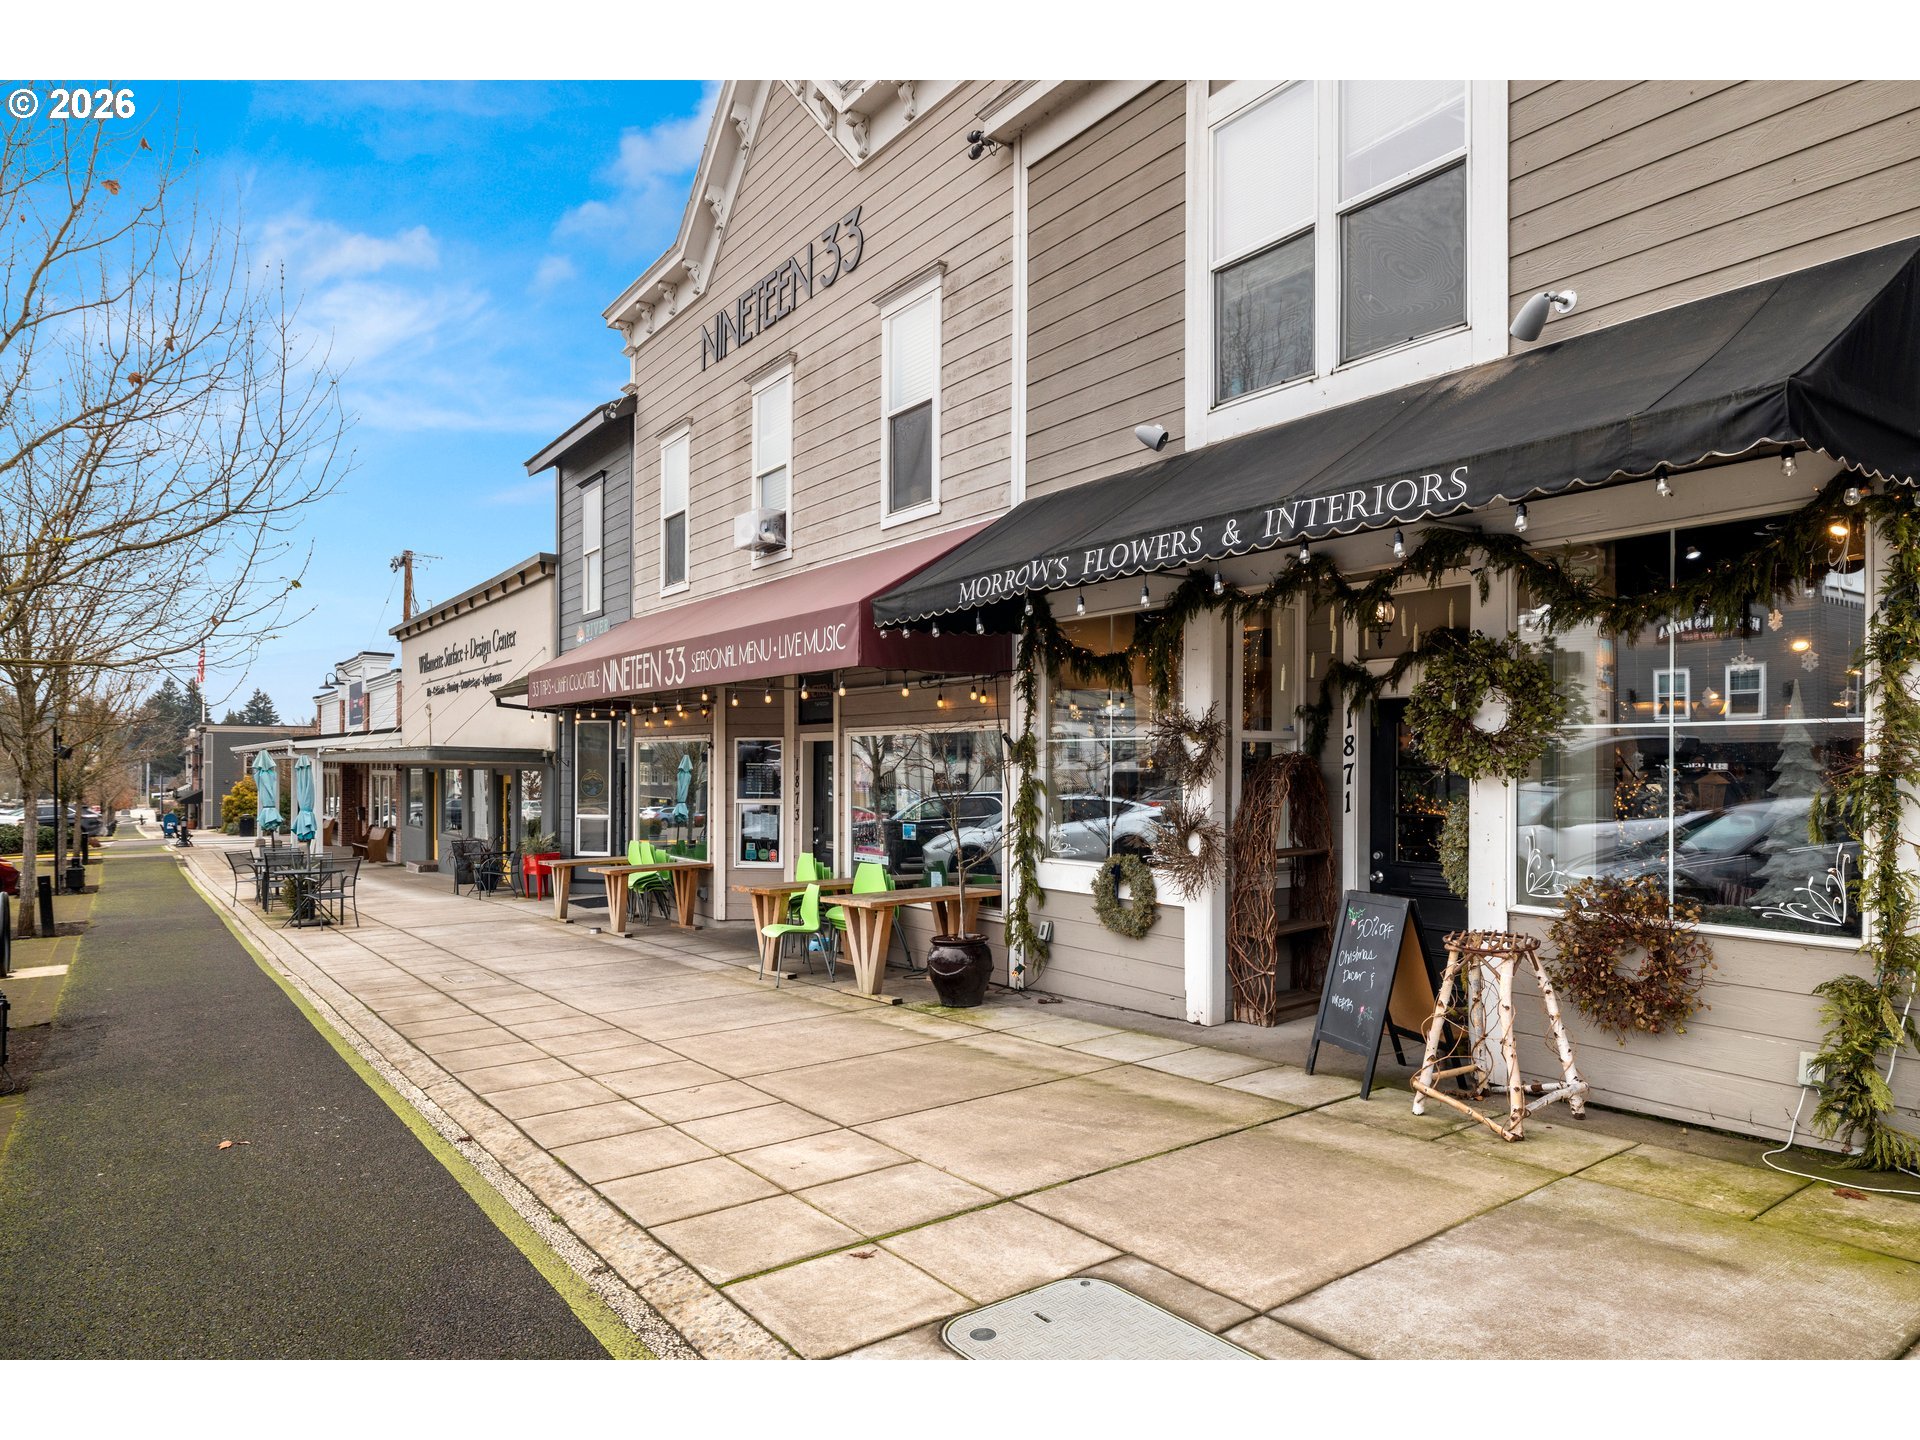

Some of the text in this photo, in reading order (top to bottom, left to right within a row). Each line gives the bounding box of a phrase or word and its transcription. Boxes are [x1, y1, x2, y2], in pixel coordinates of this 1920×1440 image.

[701, 205, 864, 372] NINETEEN 33
[958, 466, 1468, 604] MORROW'S FLOWERS & INTERIORS
[443, 642, 464, 667] Surface
[470, 636, 491, 664] Design
[492, 629, 517, 652] Center
[531, 681, 539, 697] 33
[539, 678, 551, 696] TAPS
[569, 668, 600, 692] COCKTAILS
[602, 650, 662, 693] NINETEEN
[664, 646, 686, 686] 33
[691, 644, 737, 673] SEASONAL
[738, 637, 772, 666] MENU
[778, 631, 802, 659] LIVE
[803, 623, 847, 656] MUSIC
[1343, 706, 1355, 814] 1871
[1357, 916, 1395, 939] 50% OFF
[1338, 946, 1377, 967] Christmas
[1342, 969, 1366, 983] Decor
